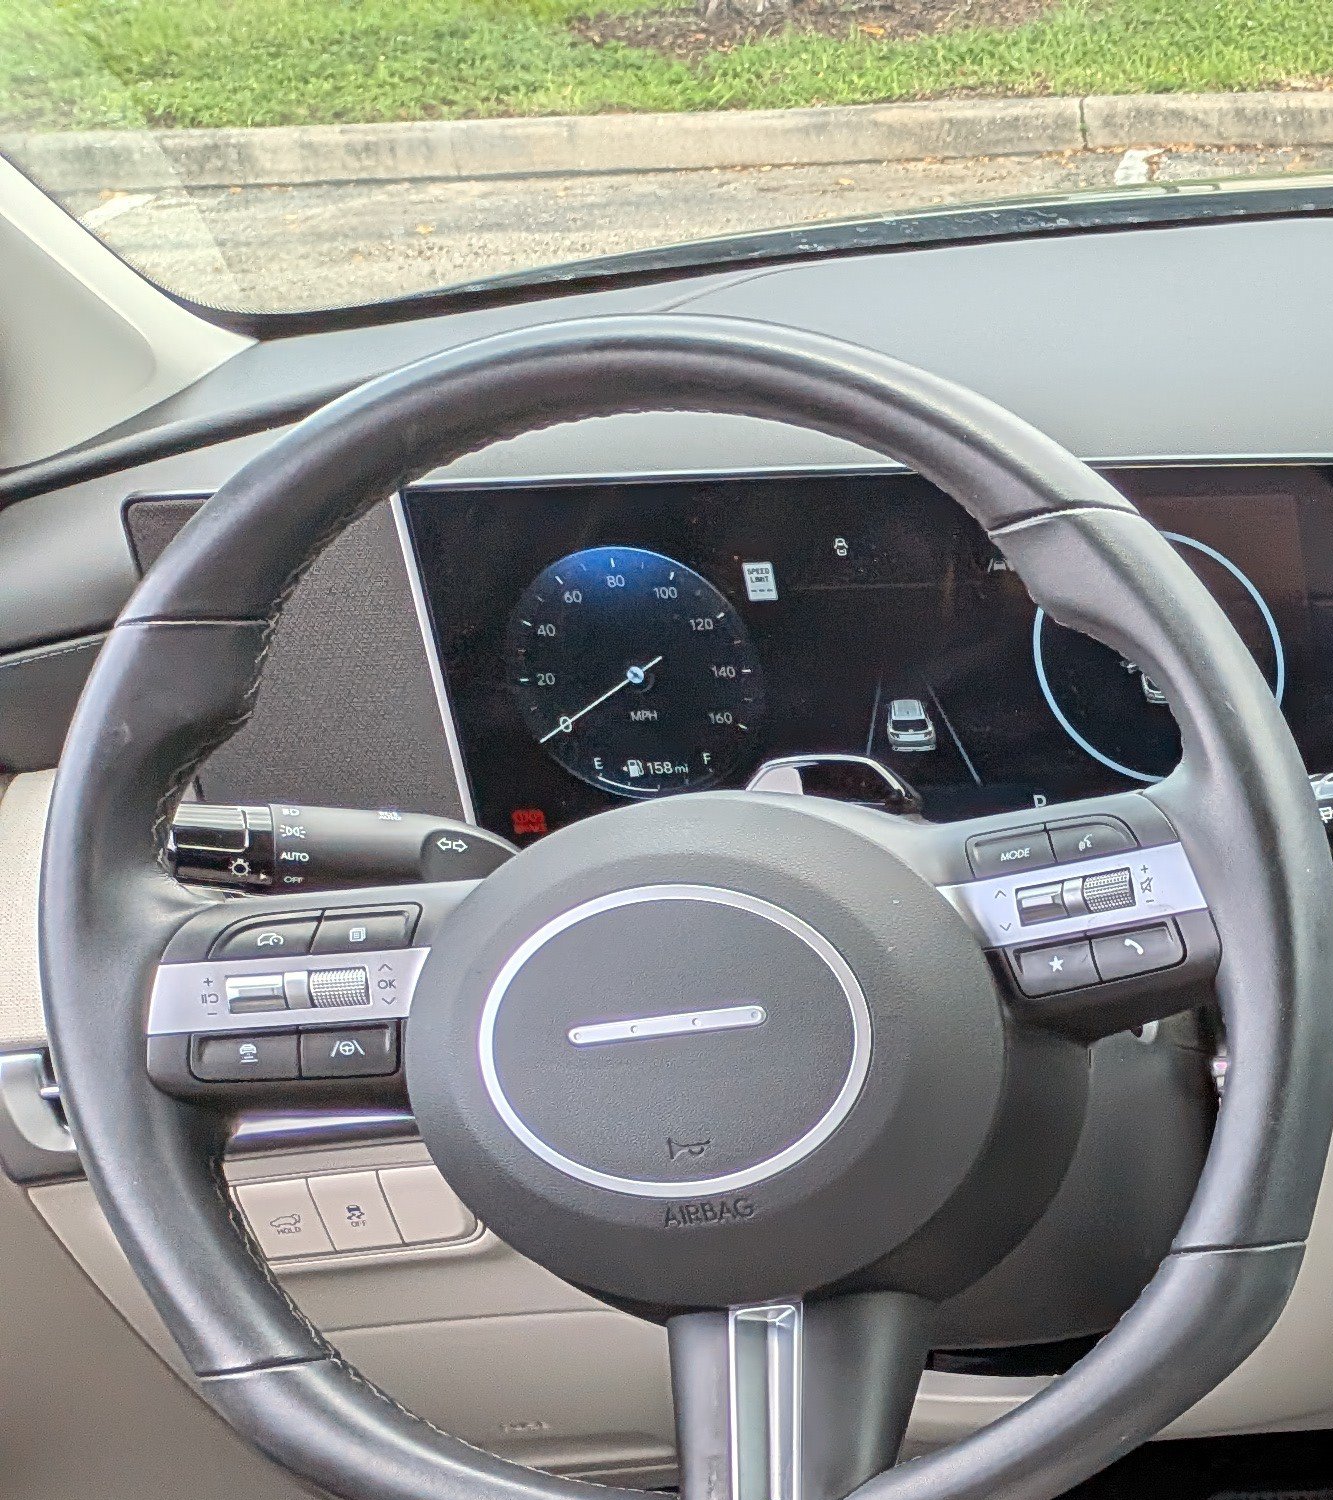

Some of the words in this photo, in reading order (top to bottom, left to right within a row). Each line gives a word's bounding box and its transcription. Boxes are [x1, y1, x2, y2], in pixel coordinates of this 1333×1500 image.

[606, 575, 625, 588] 80
[564, 590, 582, 604] 60
[653, 587, 678, 600] 100
[537, 624, 556, 637] 40
[690, 619, 714, 632] 120
[712, 666, 736, 678] 140
[537, 673, 556, 686] 20
[630, 710, 658, 721] MPH
[708, 712, 733, 725] 160
[594, 757, 604, 770] E
[703, 752, 712, 765] F
[647, 762, 673, 774] 158
[675, 763, 689, 773] mi
[280, 850, 309, 862] AUTO
[1000, 848, 1031, 861] MODE
[377, 979, 397, 990] OK
[663, 1198, 756, 1229] AIRBAG
[276, 1226, 302, 1236] HOLD
